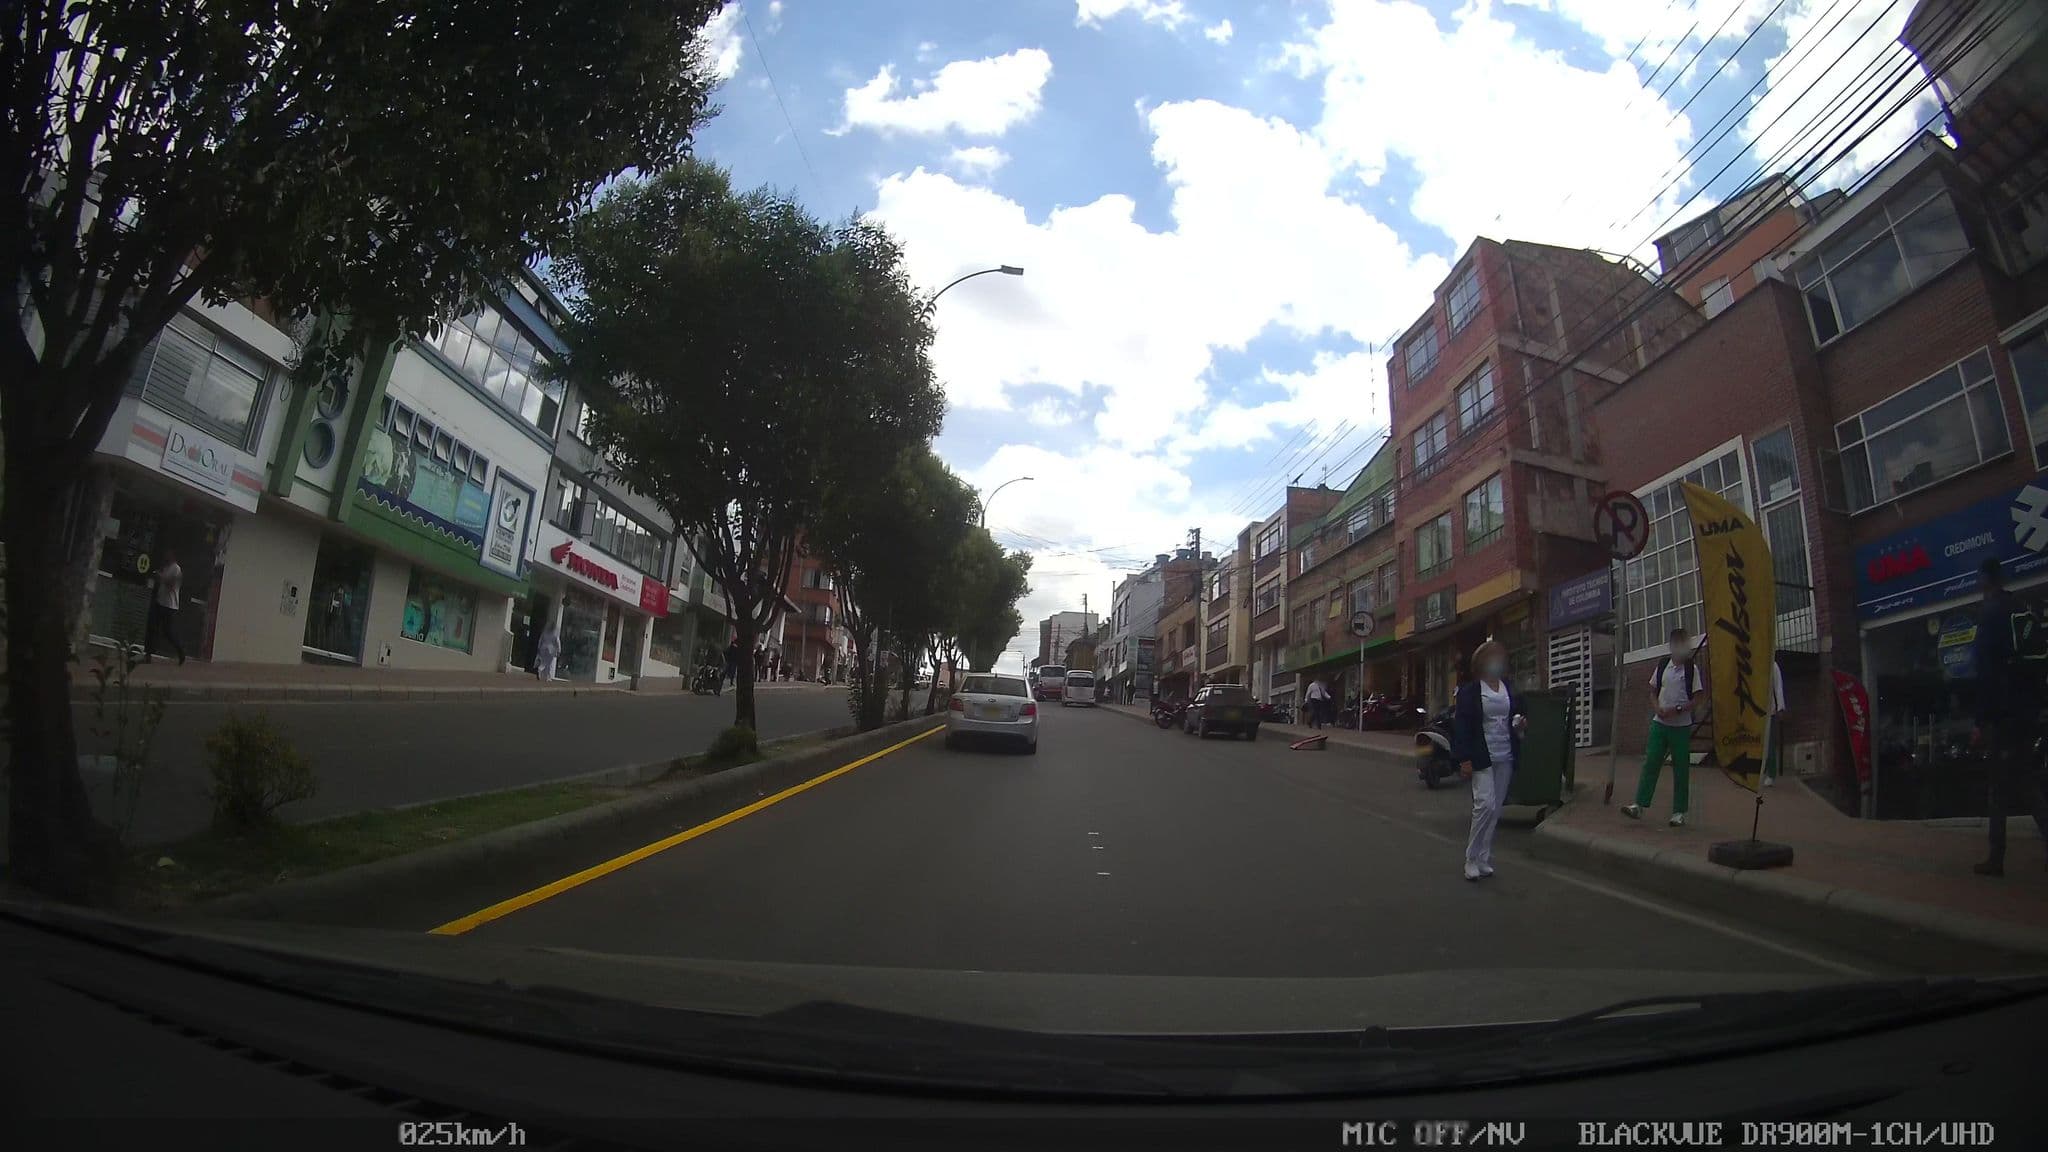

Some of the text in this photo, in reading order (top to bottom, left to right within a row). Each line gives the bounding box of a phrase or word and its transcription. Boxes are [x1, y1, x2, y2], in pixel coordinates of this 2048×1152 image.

[1699, 517, 1744, 536] UMA
[1944, 531, 1995, 557] CREDIMOVIL
[1867, 543, 1934, 584] UMA
